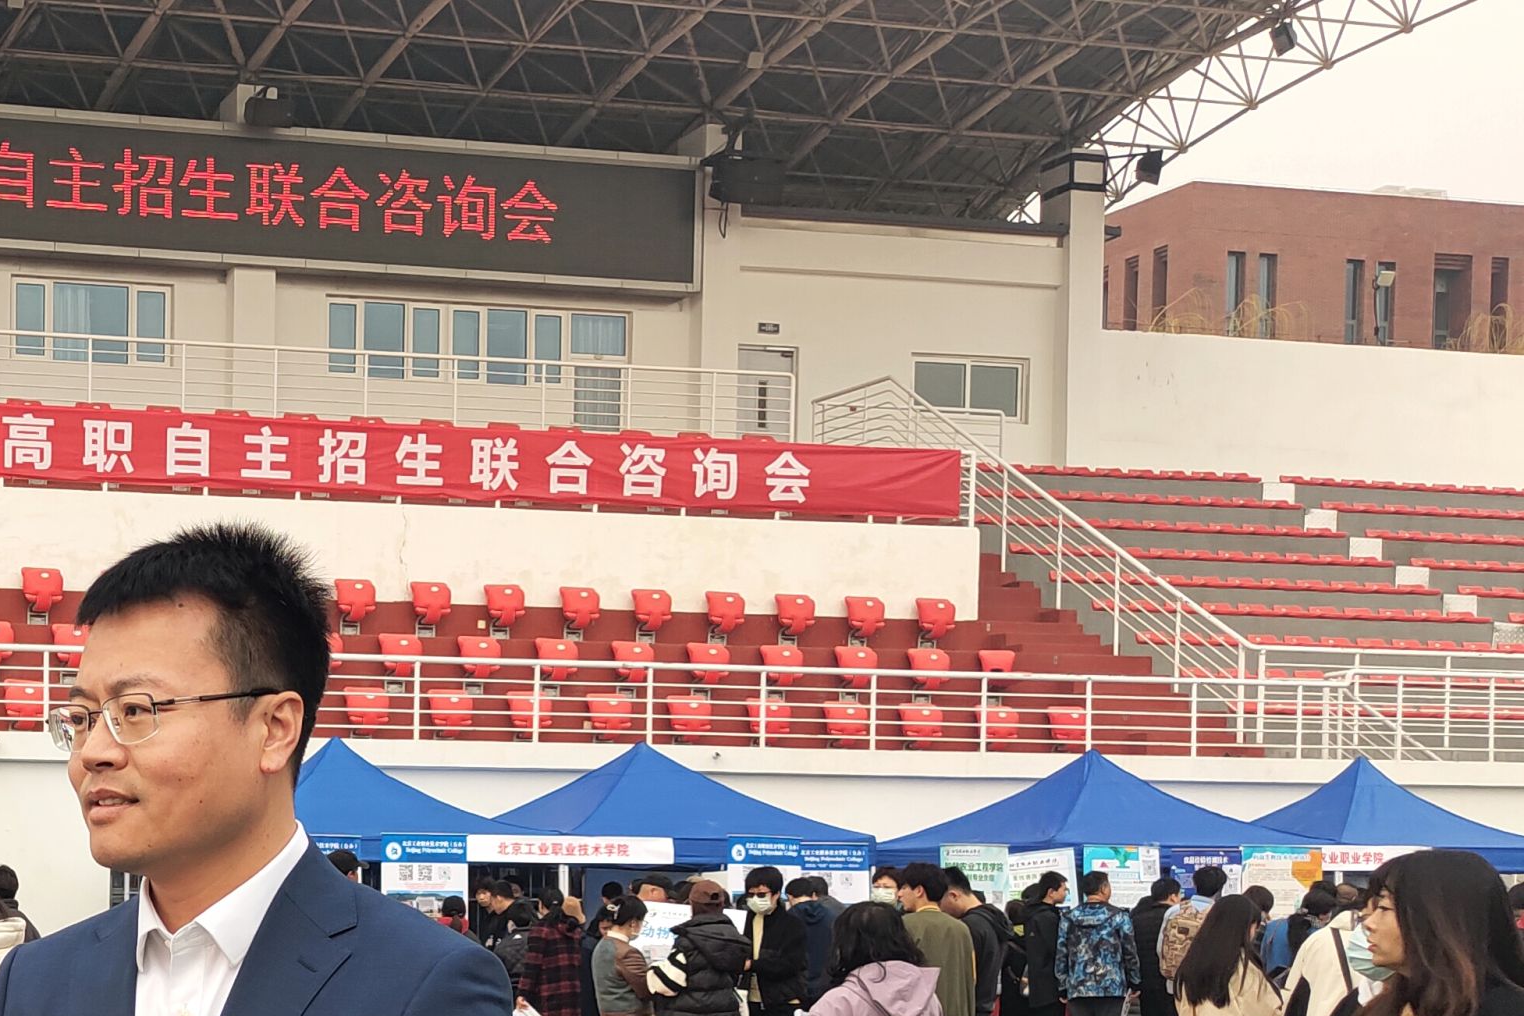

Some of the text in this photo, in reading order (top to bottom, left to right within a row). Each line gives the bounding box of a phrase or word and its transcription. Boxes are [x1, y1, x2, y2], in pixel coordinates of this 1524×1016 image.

[498, 842, 630, 857] 北京工业职业技术学院
[641, 925, 678, 940] 动物
